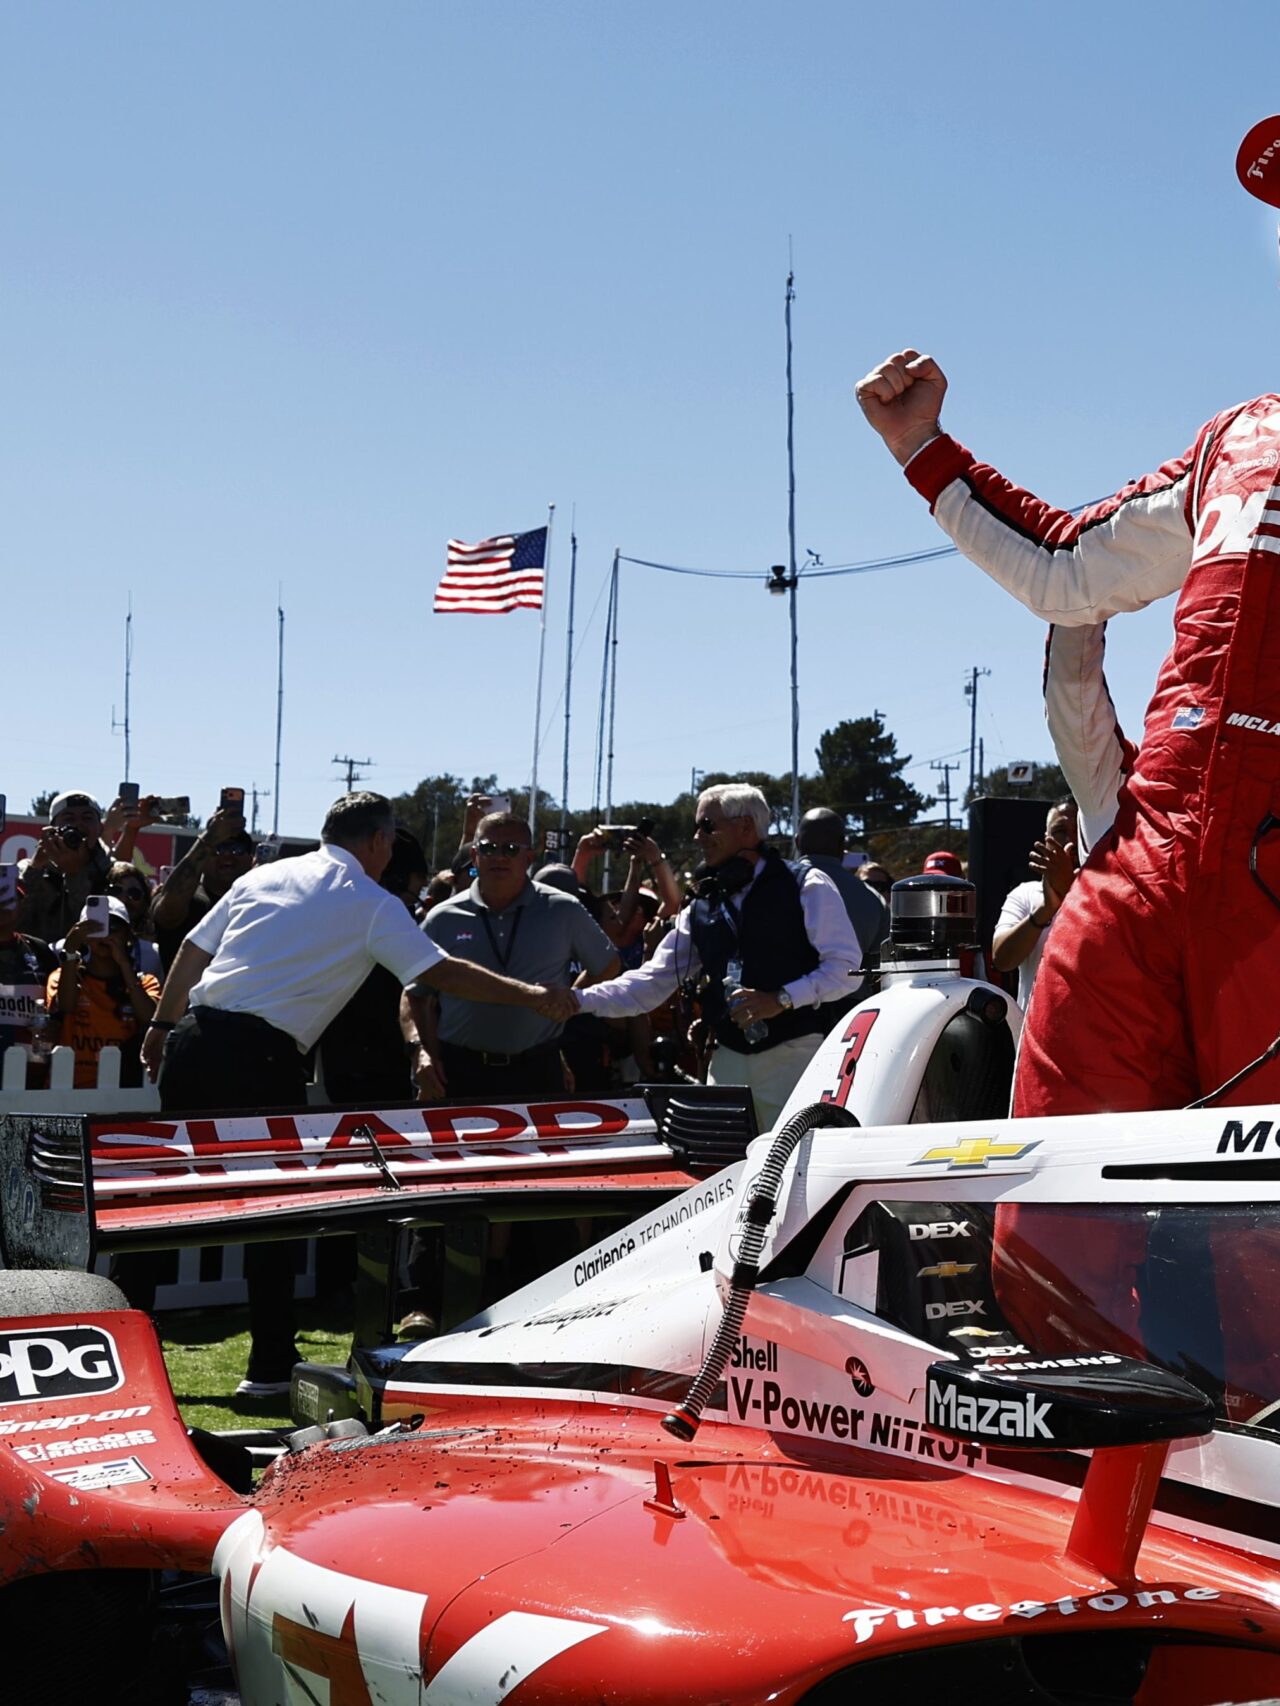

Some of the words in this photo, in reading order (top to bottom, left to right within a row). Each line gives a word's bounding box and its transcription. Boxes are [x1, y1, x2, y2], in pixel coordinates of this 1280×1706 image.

[820, 1008, 880, 1108] 3
[91, 1100, 631, 1180] SHARP
[573, 1236, 636, 1288] Clarience
[640, 1178, 735, 1246] TECHNOLOGIES
[908, 1221, 973, 1241] DEX
[924, 1299, 988, 1320] DEX
[730, 1335, 778, 1373] Shell
[966, 1342, 1031, 1358] DEX
[973, 1355, 1123, 1372] SIEMENS
[730, 1376, 865, 1440] V-Power
[928, 1379, 1055, 1439] Mazak
[45, 1429, 154, 1451] GOOD
[48, 1435, 158, 1459] RANCHERS
[842, 1586, 1222, 1644] Firestone
